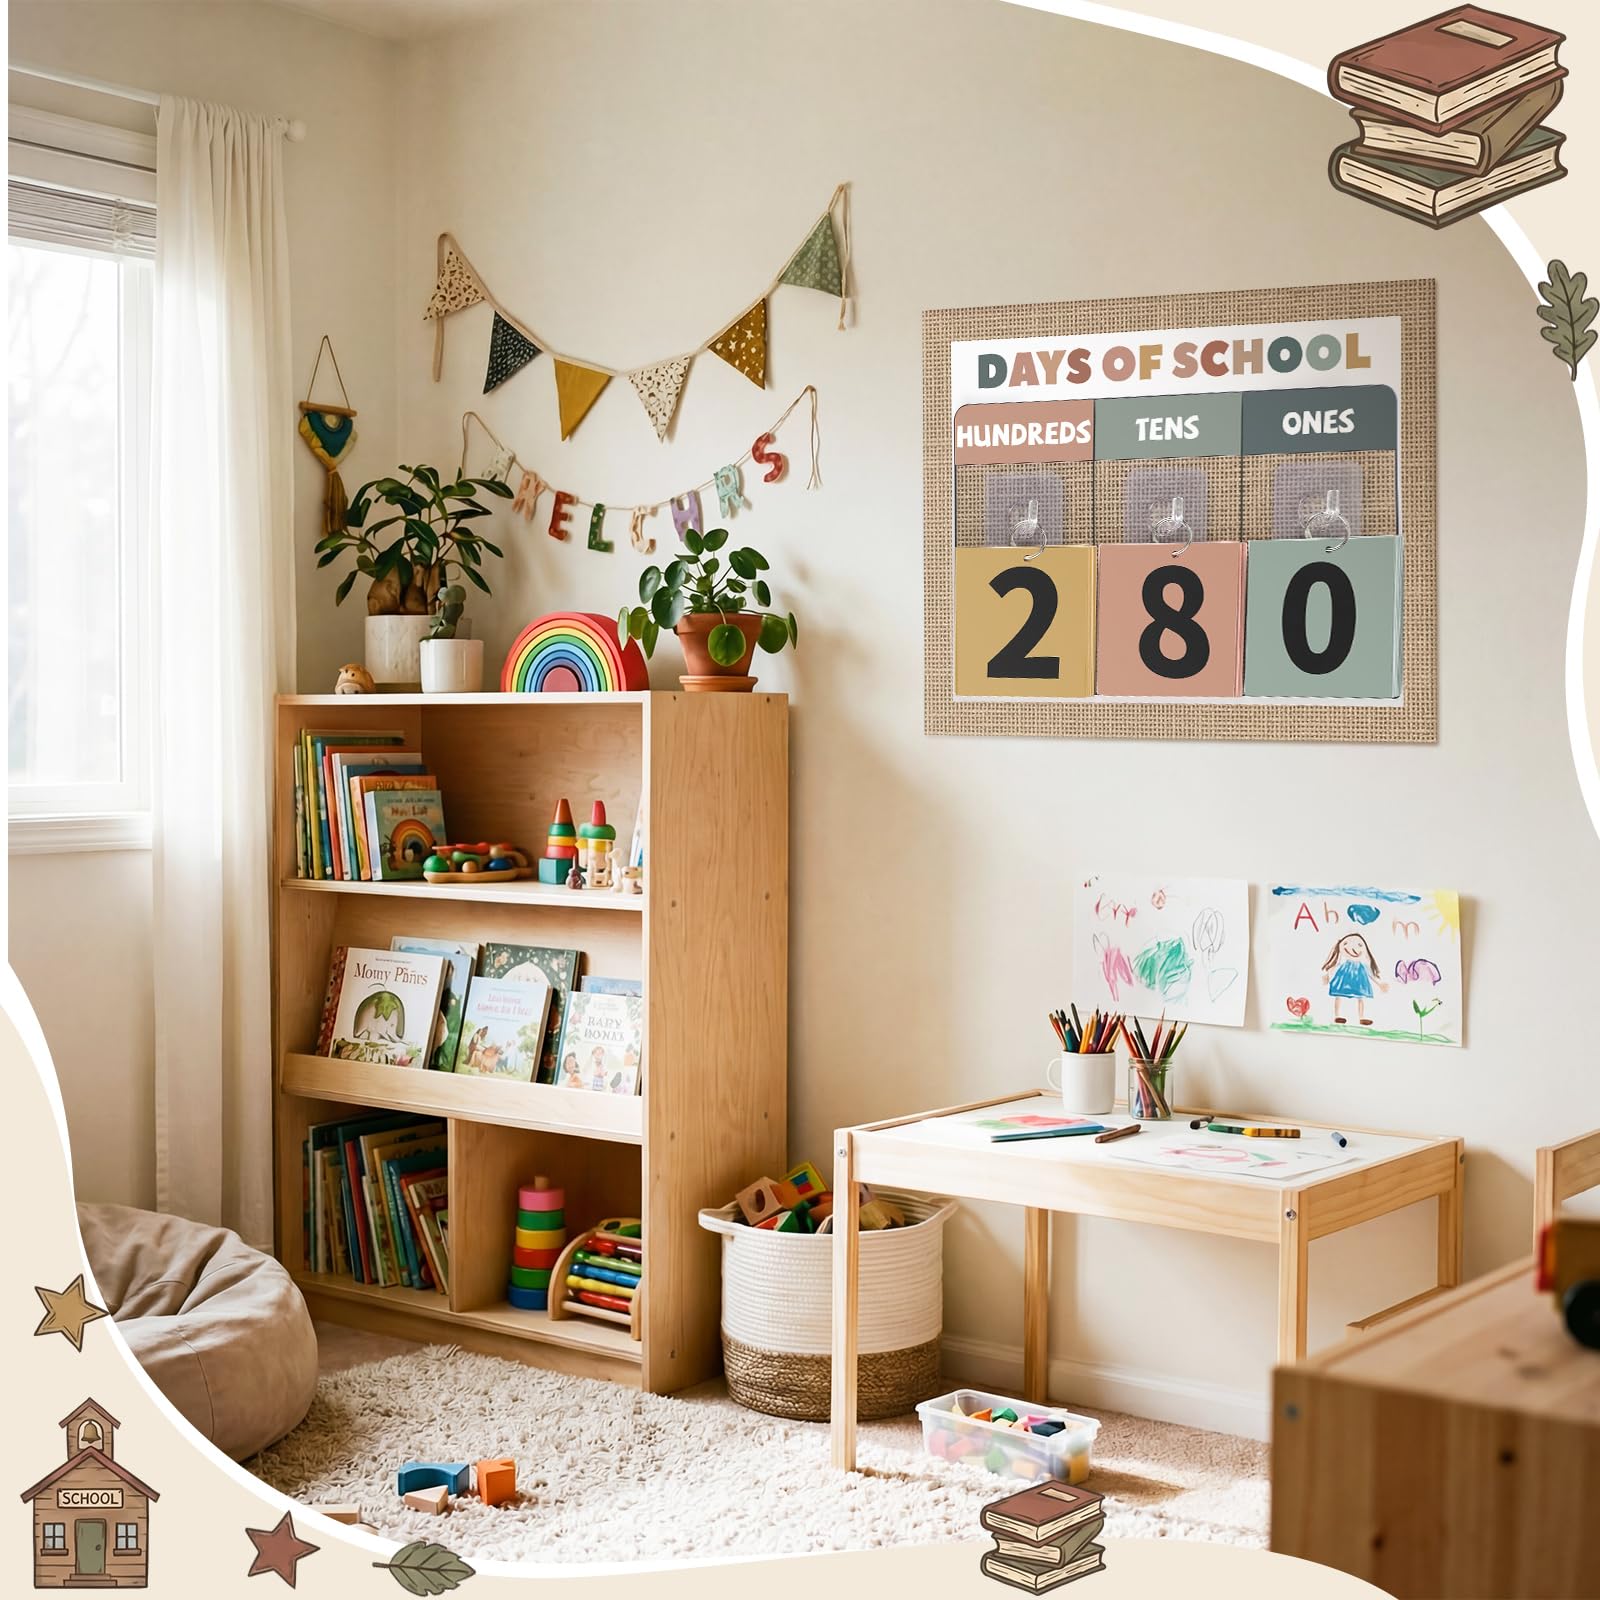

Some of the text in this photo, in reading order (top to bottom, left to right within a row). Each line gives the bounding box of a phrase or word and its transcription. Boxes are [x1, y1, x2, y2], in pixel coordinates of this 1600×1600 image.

[977, 332, 1372, 389] DAYS OF SCHOOL
[956, 419, 1092, 449] HUNDREDS
[1135, 414, 1200, 442] TENS
[1281, 408, 1356, 437] ONES
[986, 561, 1357, 680] 2 8 0
